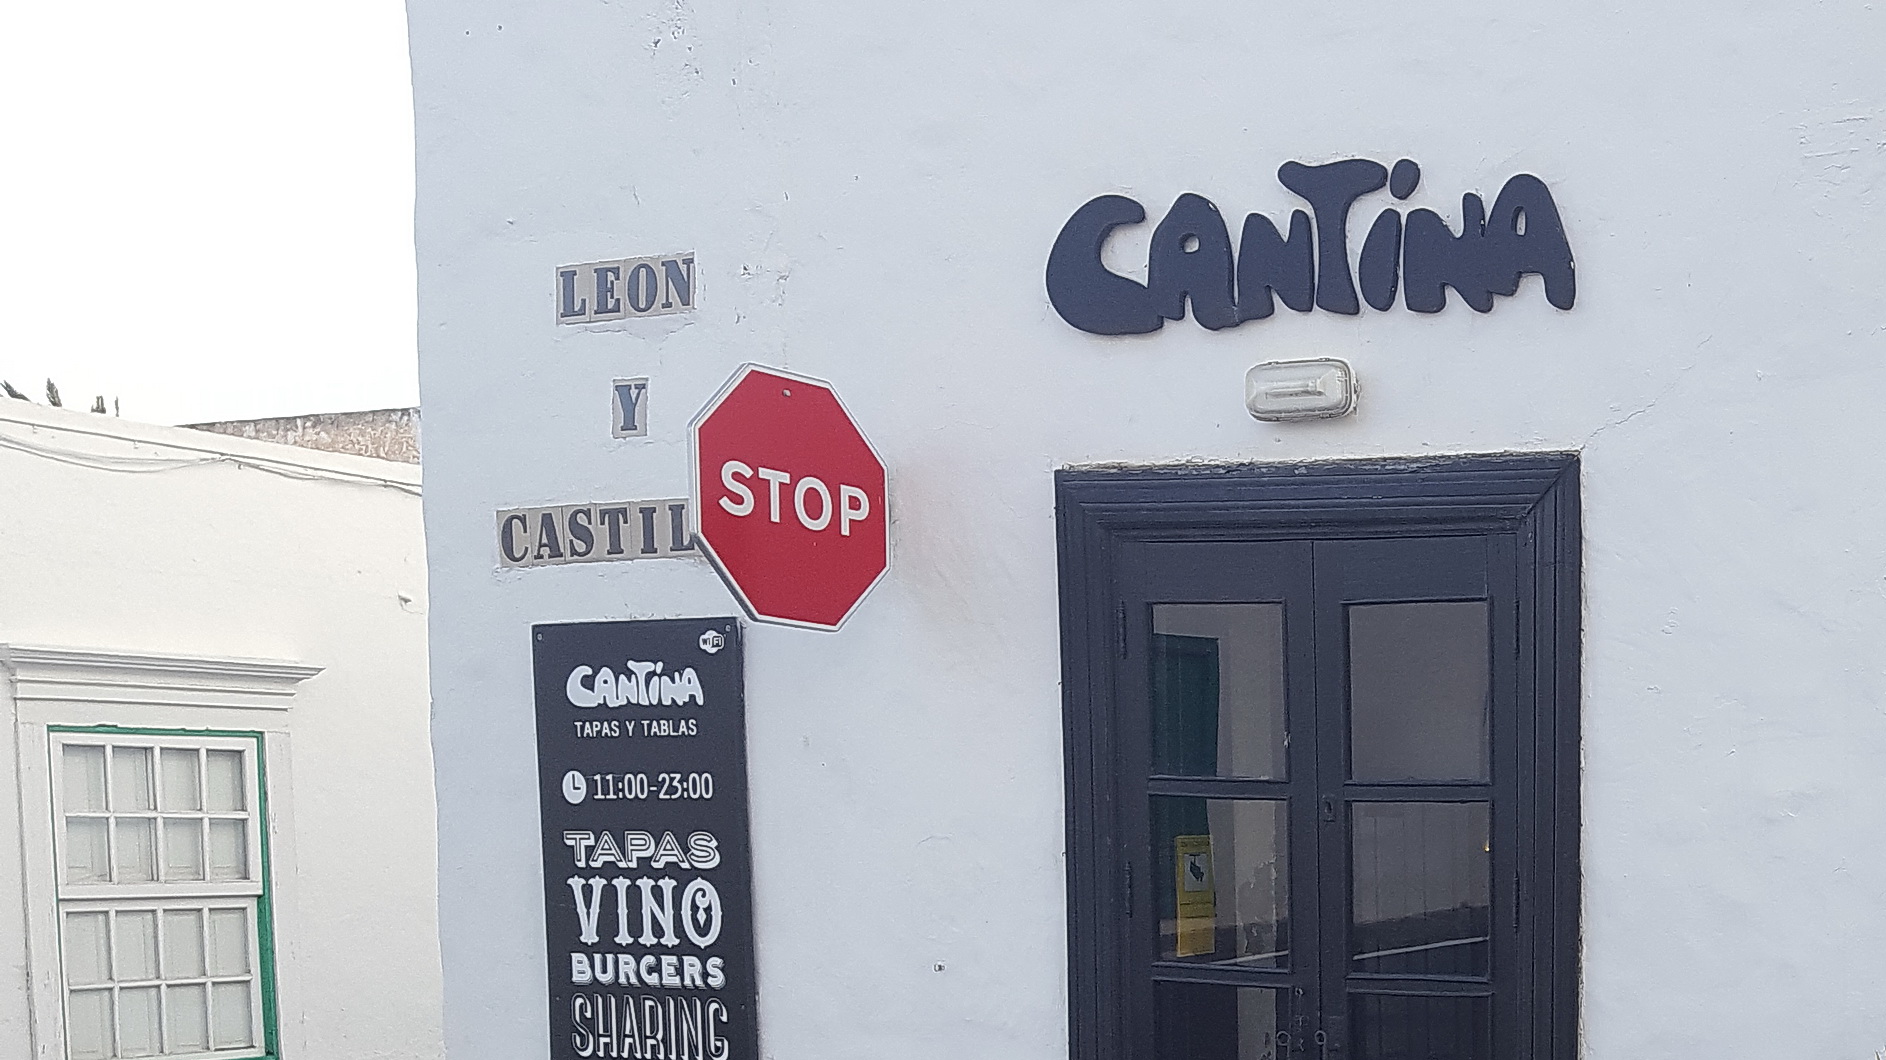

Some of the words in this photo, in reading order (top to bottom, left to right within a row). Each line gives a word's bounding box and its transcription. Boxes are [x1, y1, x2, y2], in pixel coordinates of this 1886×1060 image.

[559, 257, 694, 319] LEON
[614, 382, 646, 431] Y
[718, 460, 870, 536] STOP
[574, 720, 620, 737] TAPAS
[626, 720, 635, 737] Y
[641, 719, 698, 736] TABLAS
[592, 773, 714, 800] 11:00-23:00
[563, 831, 721, 869] TAPAS
[566, 875, 723, 949] VINO
[570, 952, 727, 989] BURGERS
